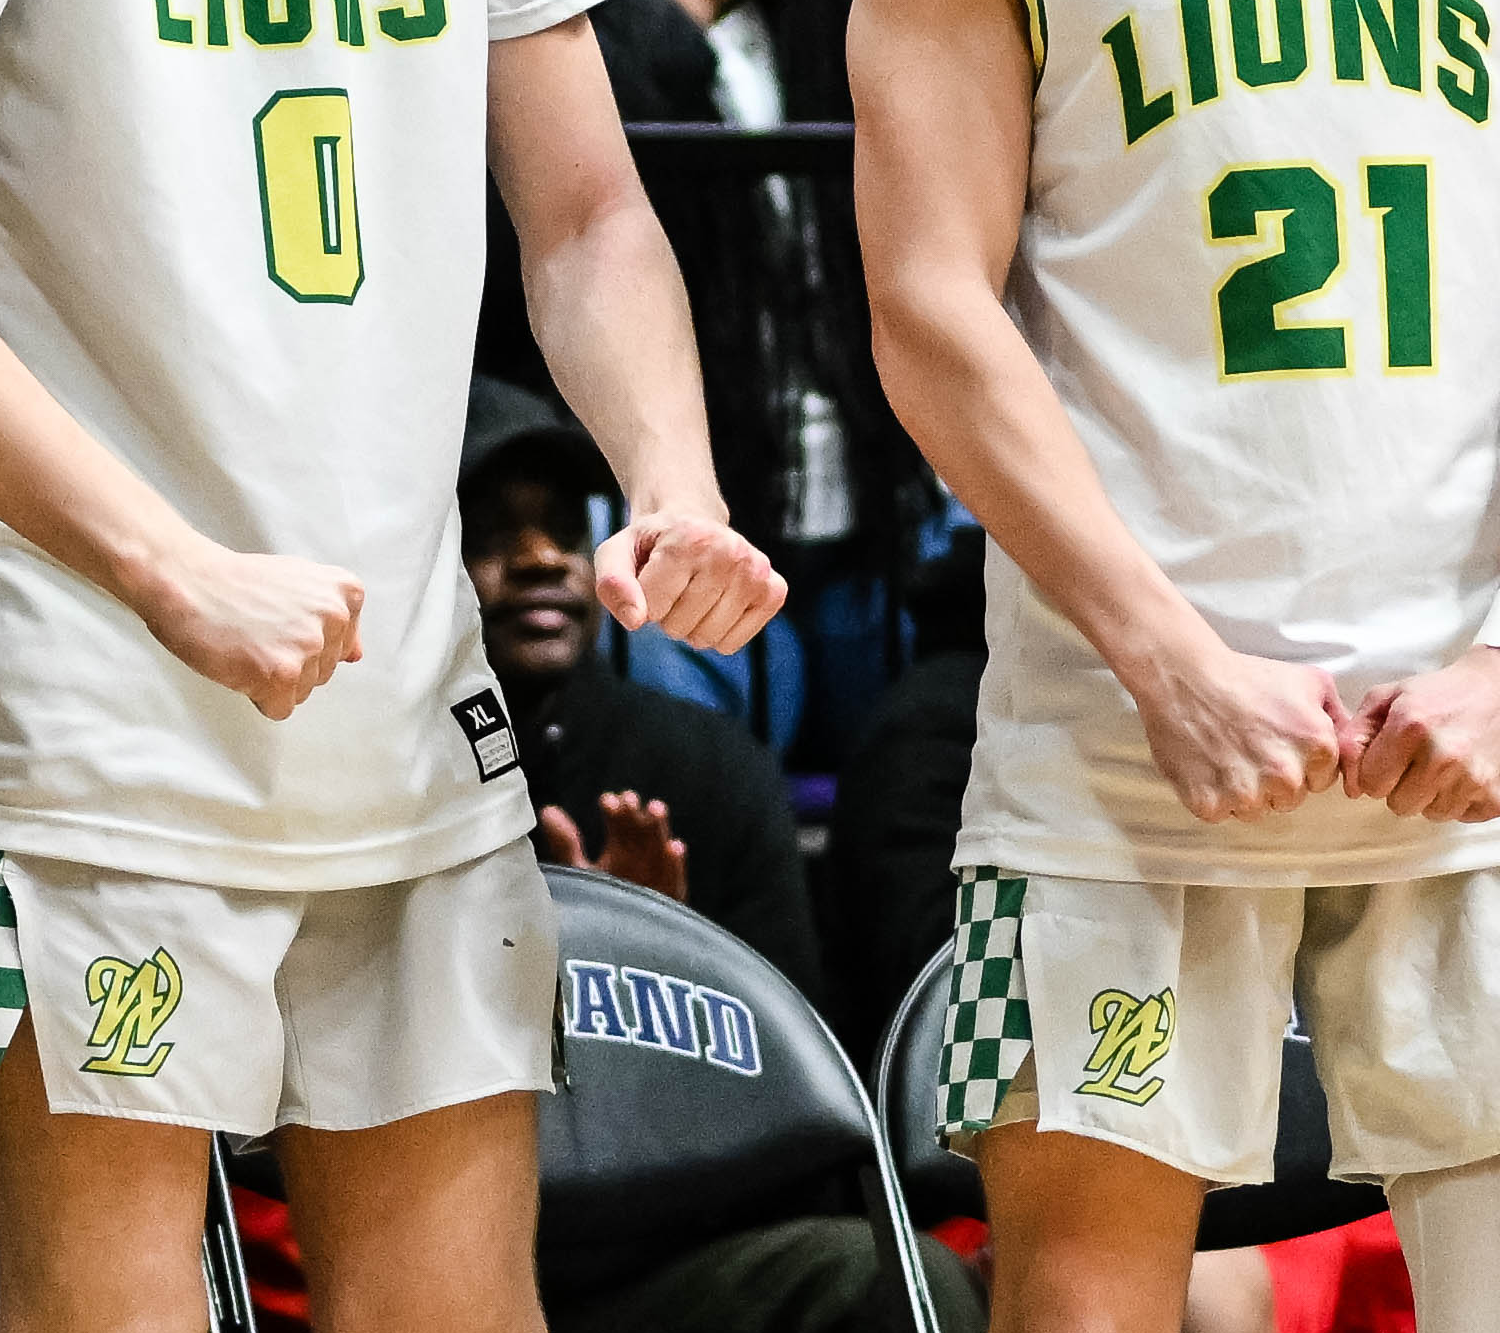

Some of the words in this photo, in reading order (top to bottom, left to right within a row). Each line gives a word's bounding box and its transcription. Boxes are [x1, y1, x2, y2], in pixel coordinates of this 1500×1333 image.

[253, 87, 366, 305] 0
[1204, 156, 1438, 384] 21
[465, 704, 497, 730] XL
